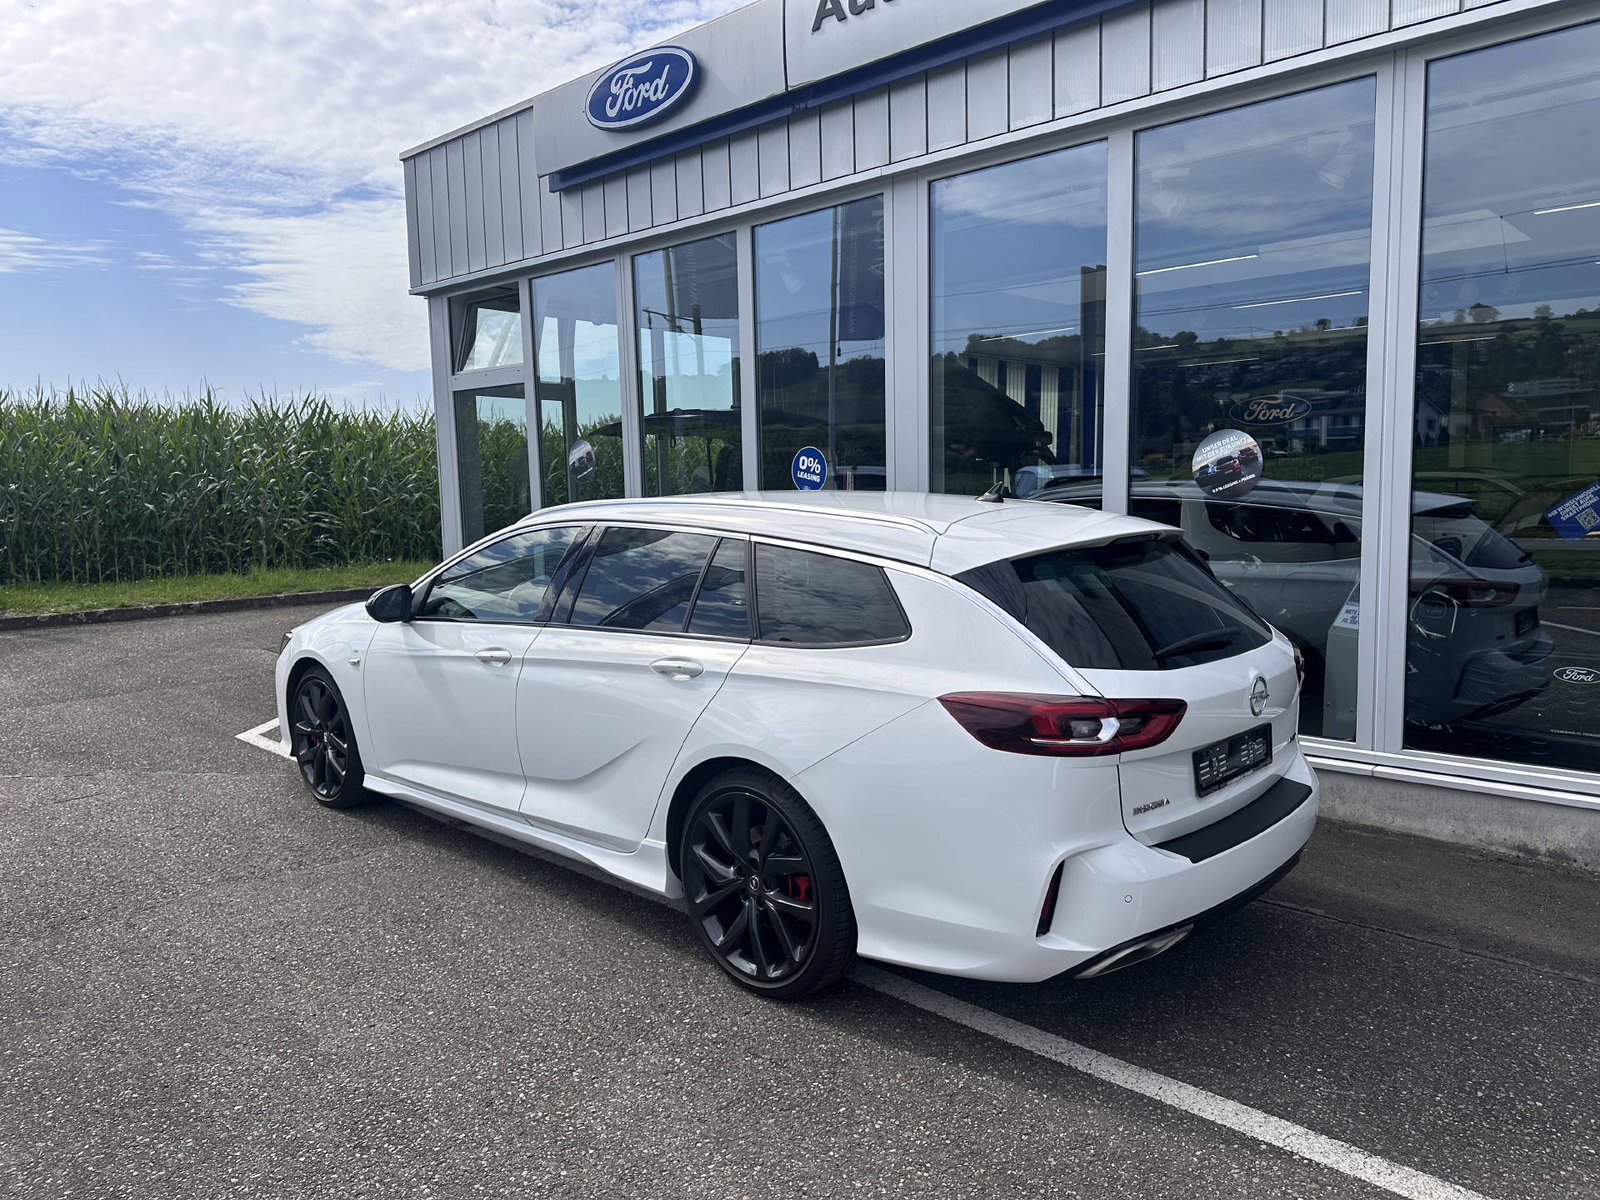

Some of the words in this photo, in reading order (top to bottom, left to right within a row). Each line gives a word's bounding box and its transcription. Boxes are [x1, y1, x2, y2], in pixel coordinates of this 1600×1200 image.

[811, 0, 895, 33] Au
[605, 61, 671, 118] Ford
[1243, 398, 1296, 421] Ford
[1222, 435, 1239, 445] DEAL
[799, 455, 821, 474] 0%
[797, 470, 821, 483] LEASING
[1563, 668, 1595, 682] Ford
